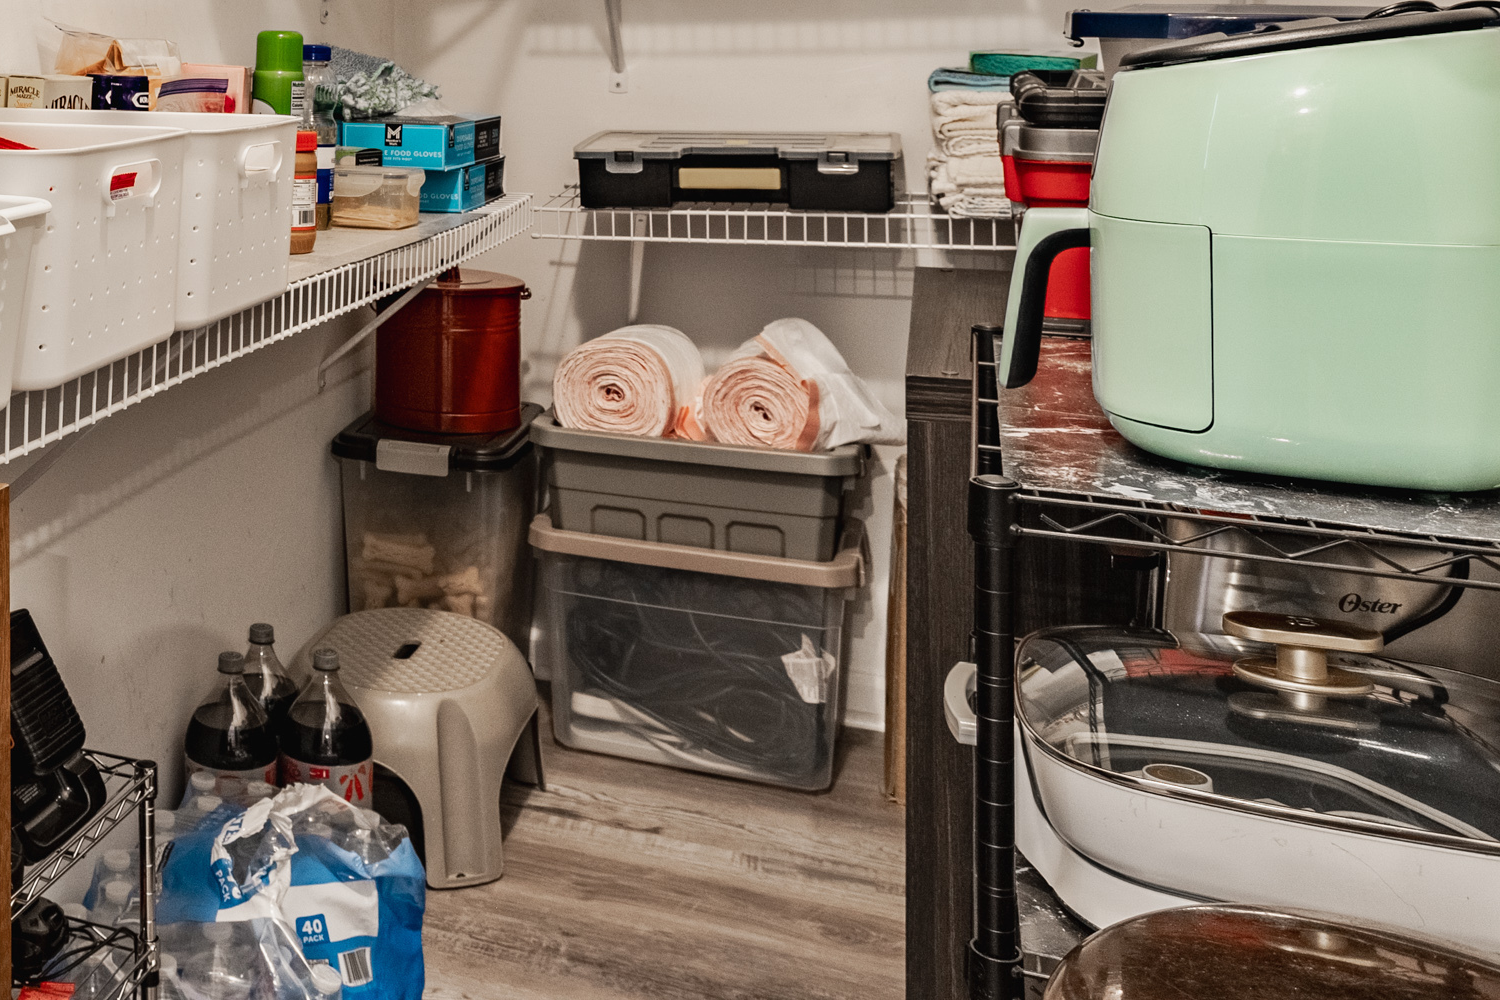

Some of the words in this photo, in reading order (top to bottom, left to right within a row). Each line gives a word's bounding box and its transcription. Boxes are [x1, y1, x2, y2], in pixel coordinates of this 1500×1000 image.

[10, 86, 41, 99] MIRACLE
[413, 150, 443, 158] GLOVES
[1338, 592, 1403, 614] Oster
[301, 918, 324, 935] 40
[302, 934, 325, 944] PACK
